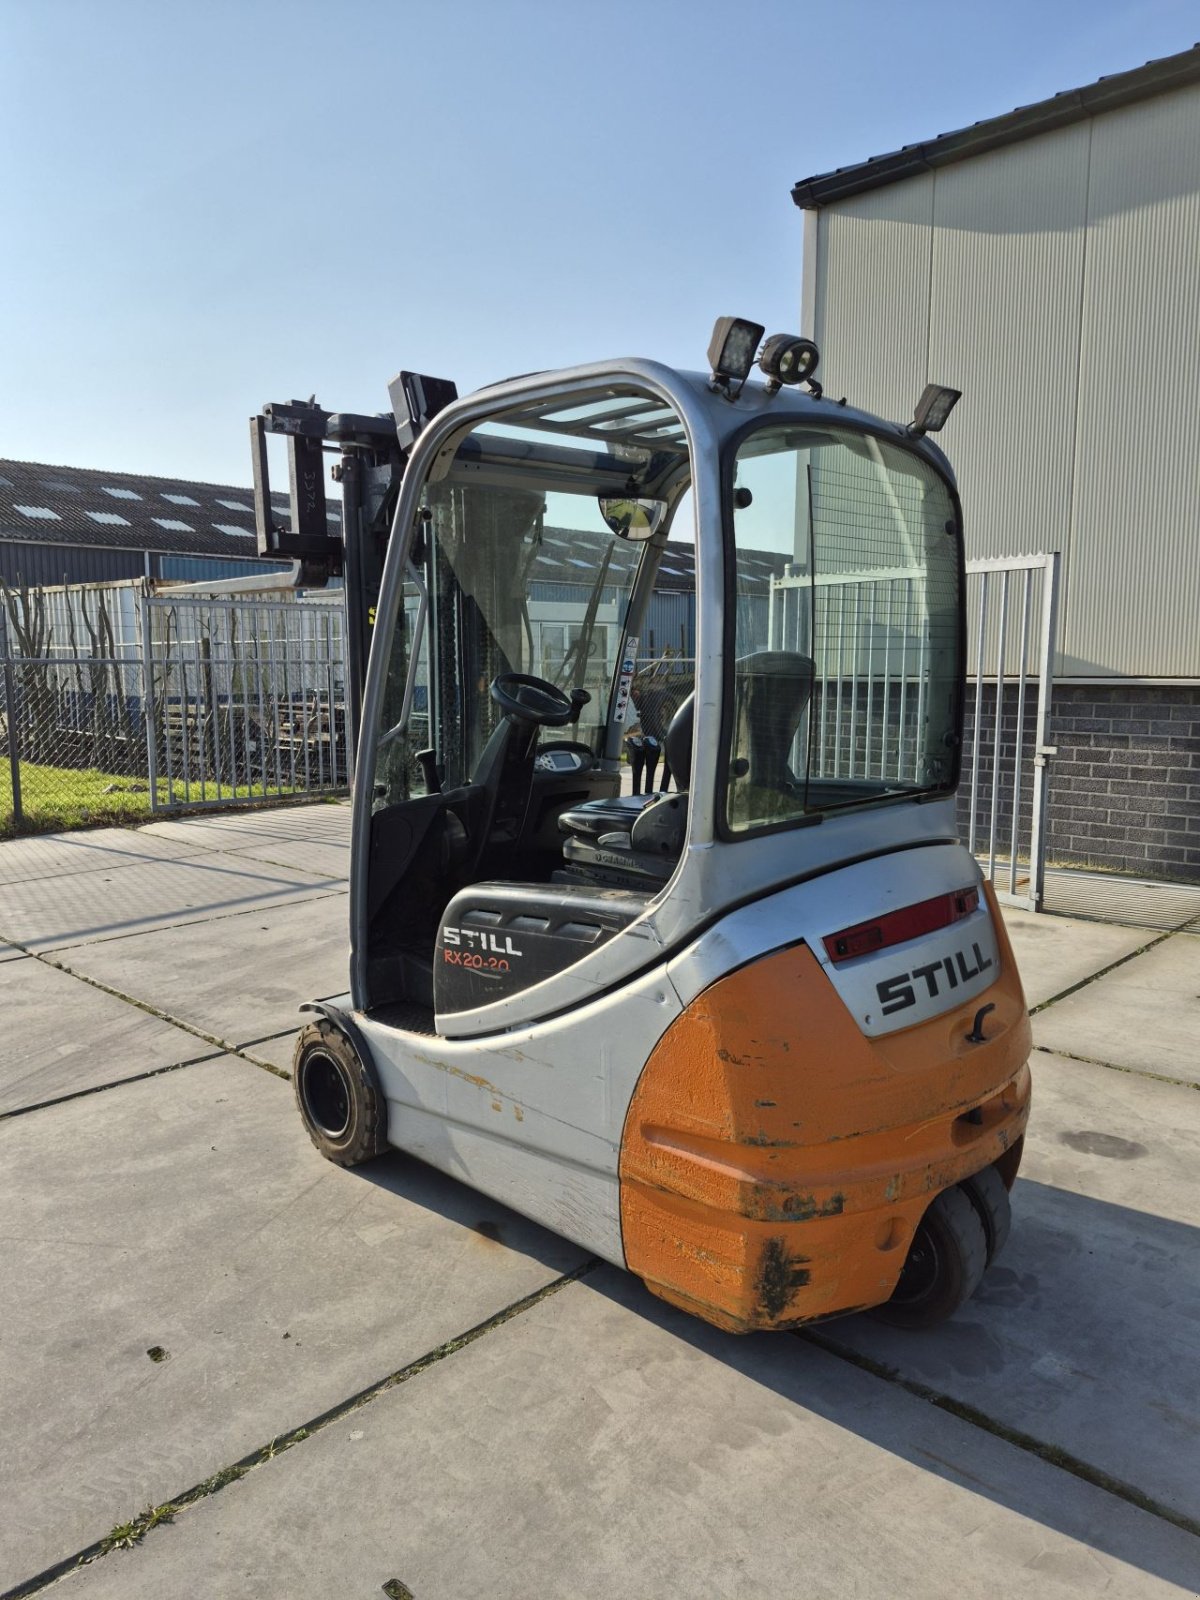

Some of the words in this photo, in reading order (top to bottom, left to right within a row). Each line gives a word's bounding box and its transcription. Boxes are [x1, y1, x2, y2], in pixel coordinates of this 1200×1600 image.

[443, 926, 523, 957] STILL
[444, 948, 511, 973] RX20-20
[876, 942, 993, 1017] STILL
